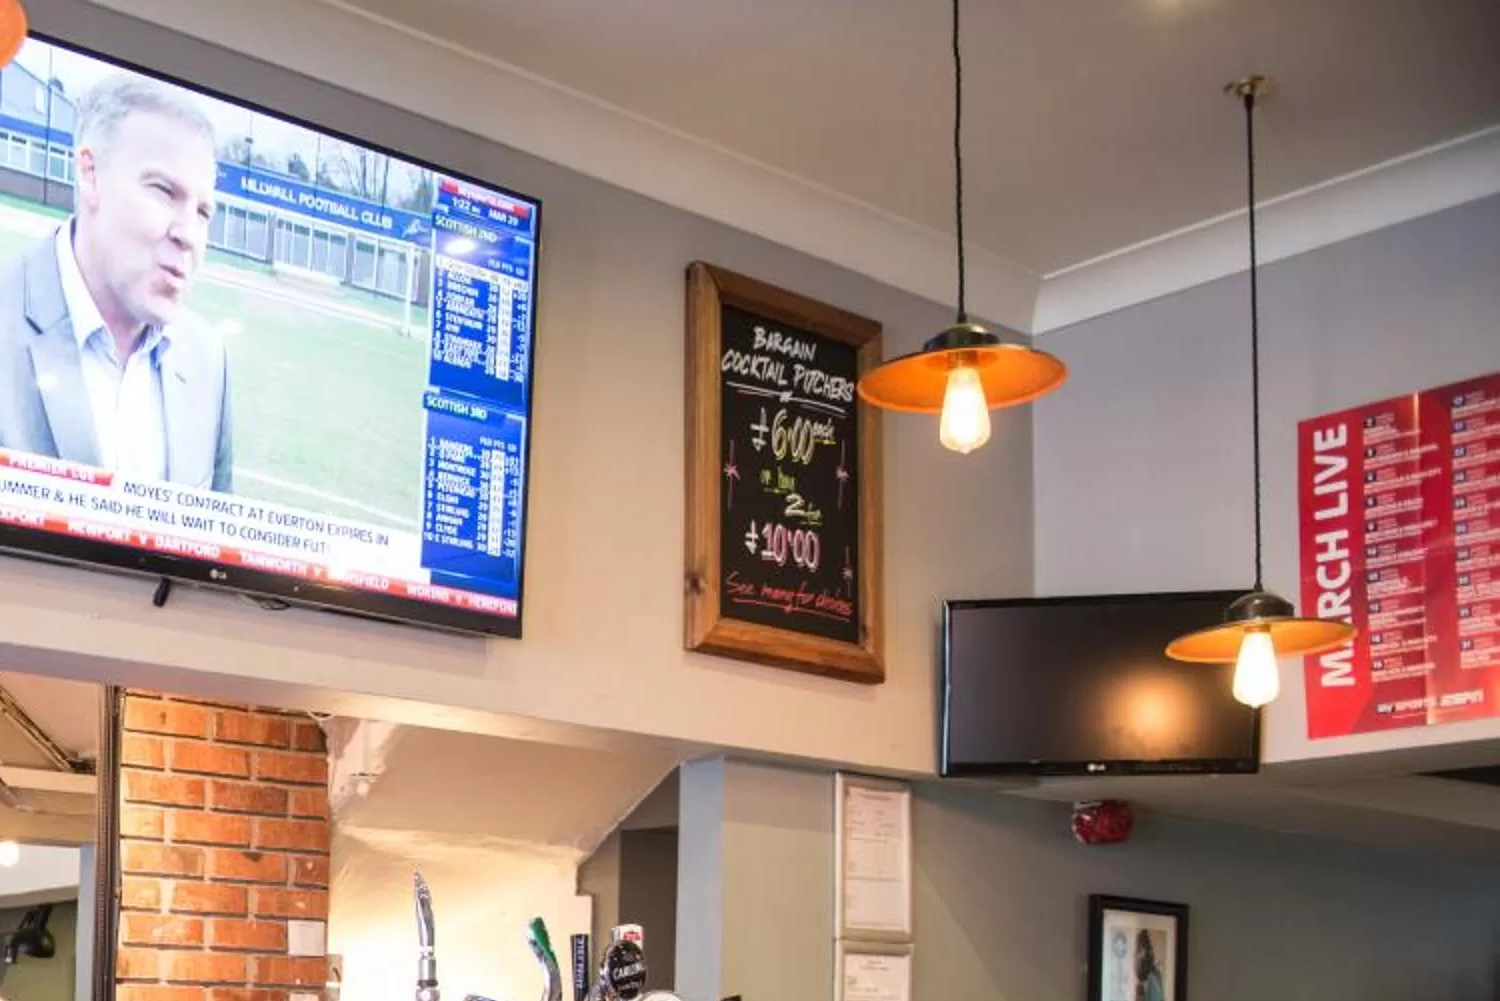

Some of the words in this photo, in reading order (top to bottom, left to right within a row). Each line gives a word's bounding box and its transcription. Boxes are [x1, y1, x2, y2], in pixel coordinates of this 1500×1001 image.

[299, 192, 358, 221] FOOTBALL
[361, 211, 393, 230] CLUB
[753, 325, 817, 361] BARGAIN
[721, 348, 788, 385] COCKTAIL
[793, 363, 854, 402] PITCHERS
[1313, 423, 1349, 520] LIVE
[53, 489, 64, 503] &
[69, 494, 86, 508] HE
[91, 498, 122, 516] SAID
[125, 503, 144, 519] HE
[147, 507, 176, 526] WILL
[181, 514, 213, 533] WAIT
[220, 521, 236, 536] TO
[239, 526, 301, 550] CONSIDER
[177, 491, 244, 516] CONTRACT
[248, 506, 265, 521] AT
[268, 512, 324, 536] EVERTON
[327, 522, 373, 544] EXPIRES
[376, 533, 389, 547] IN
[784, 493, 804, 516] 2
[1315, 529, 1356, 687] MRCH
